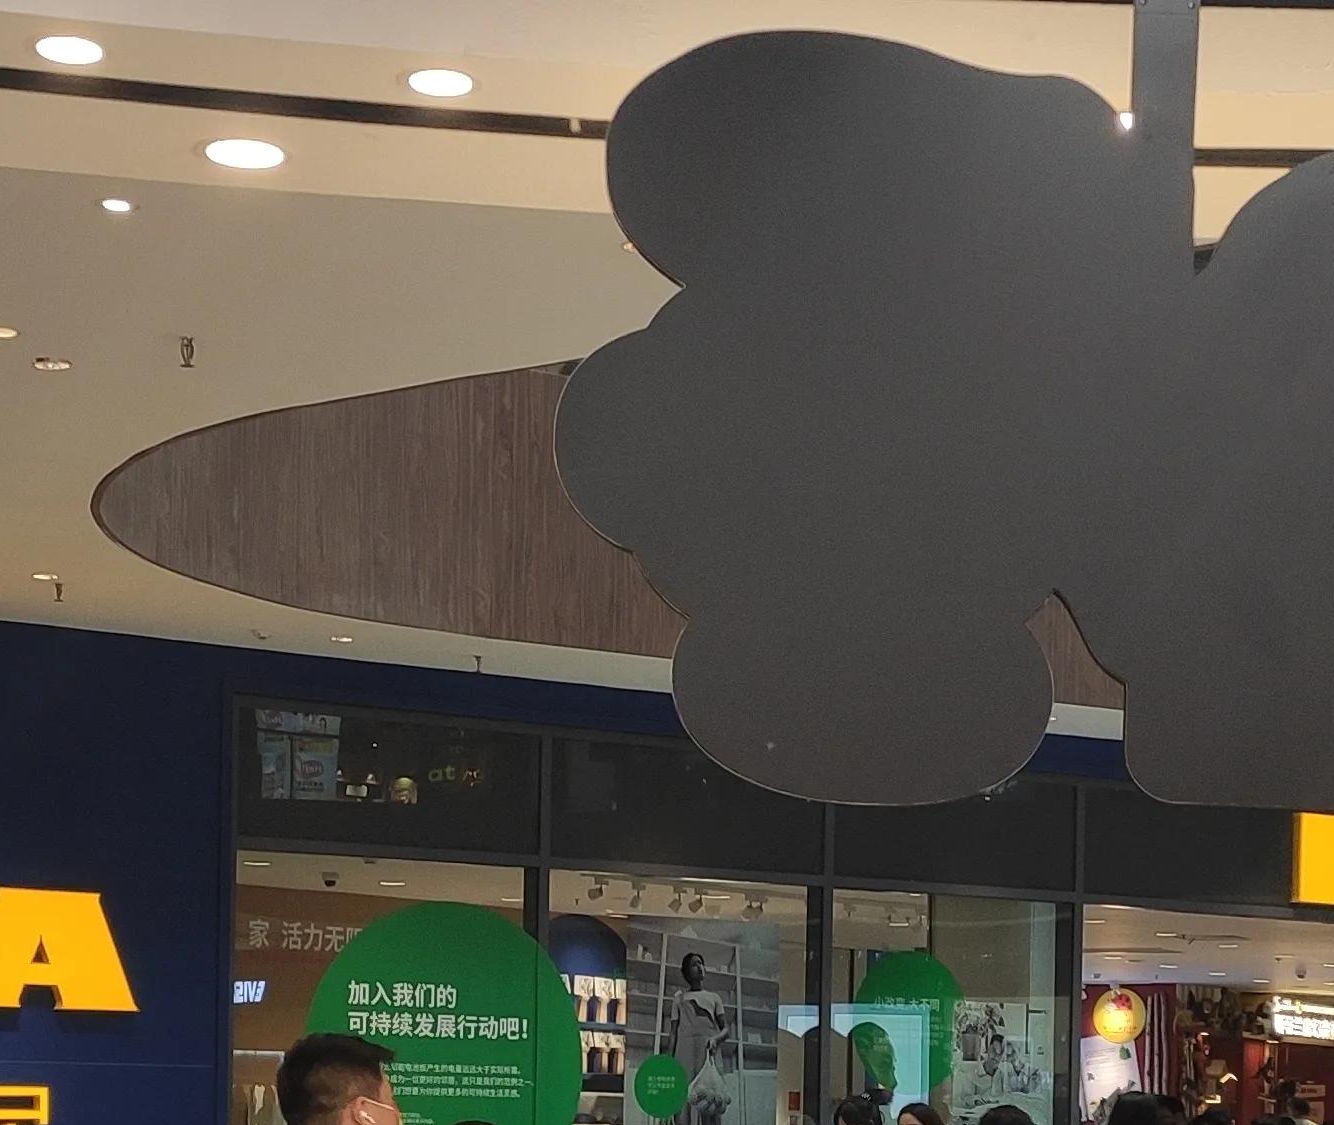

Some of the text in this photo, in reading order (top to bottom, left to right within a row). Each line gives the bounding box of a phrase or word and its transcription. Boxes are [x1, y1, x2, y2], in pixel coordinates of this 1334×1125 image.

[249, 918, 270, 949] 家
[347, 979, 458, 1009] 加入我们的
[347, 1011, 529, 1041] 可持续发展行动吧！
